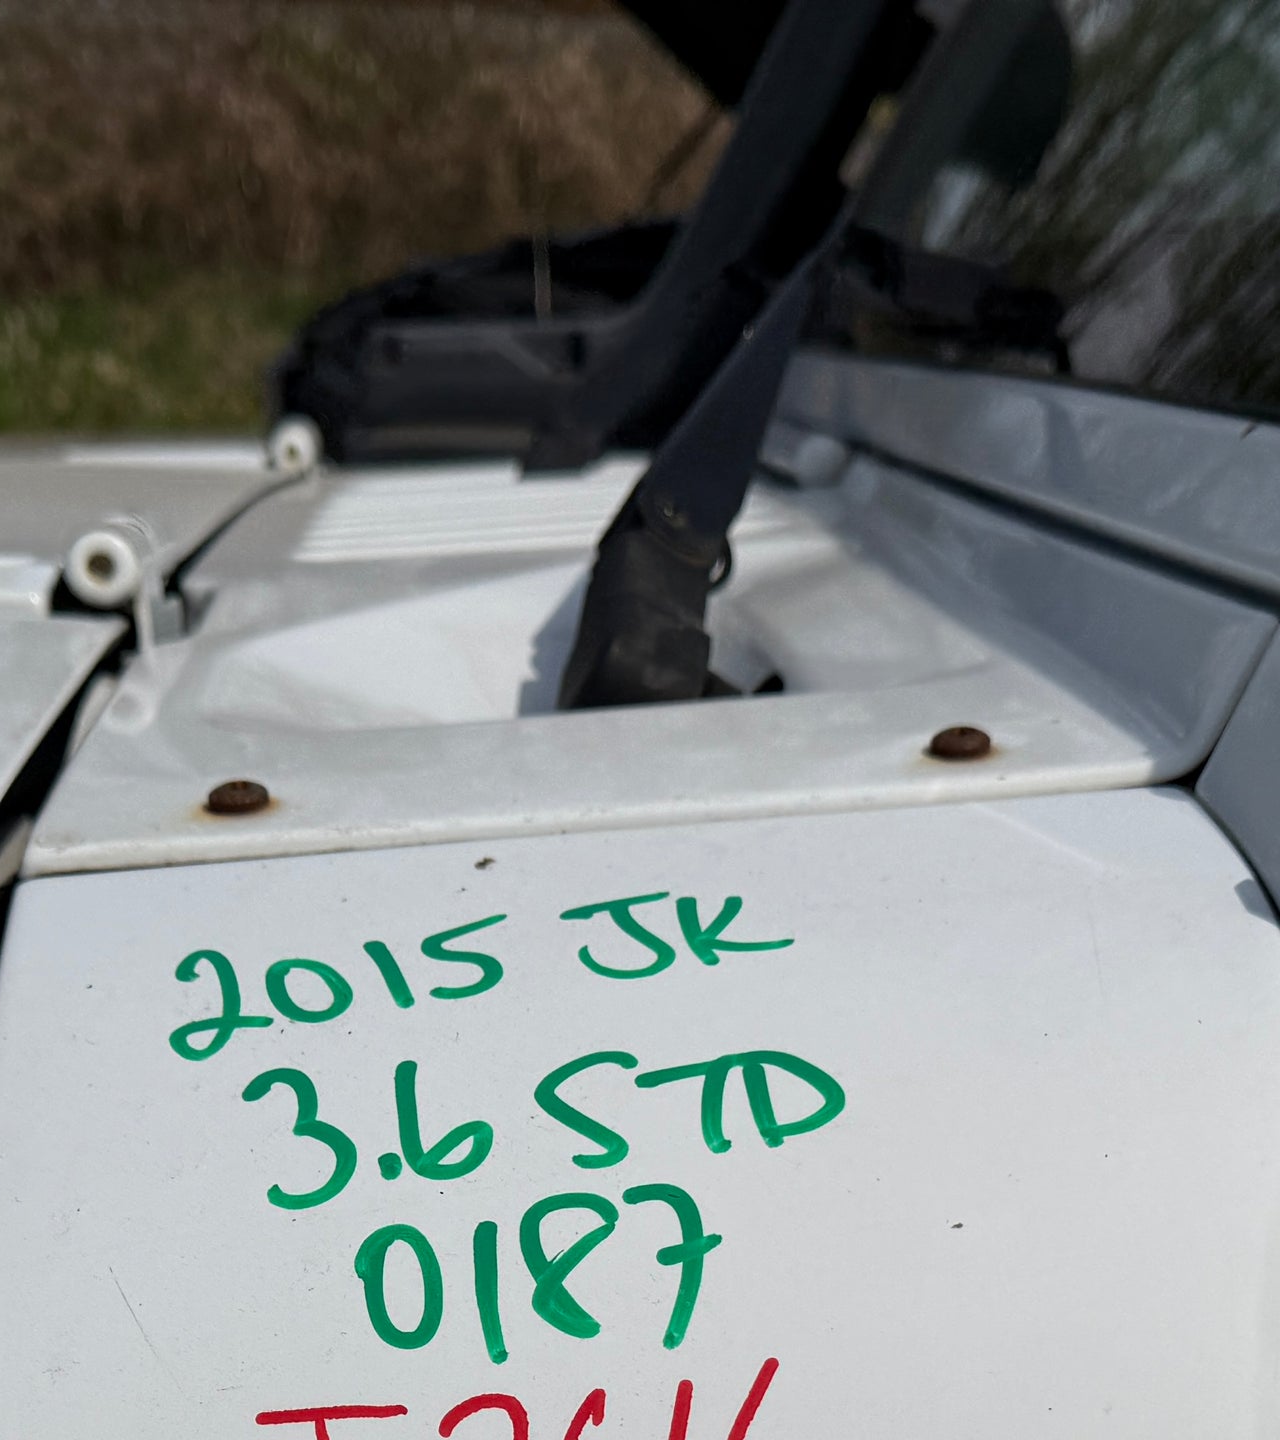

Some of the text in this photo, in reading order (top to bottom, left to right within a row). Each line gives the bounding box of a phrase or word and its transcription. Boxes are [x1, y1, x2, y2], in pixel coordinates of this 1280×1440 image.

[168, 890, 796, 1062] 2015 JK
[242, 1050, 846, 1211] 3.6 STD
[355, 1183, 724, 1366] 0187
